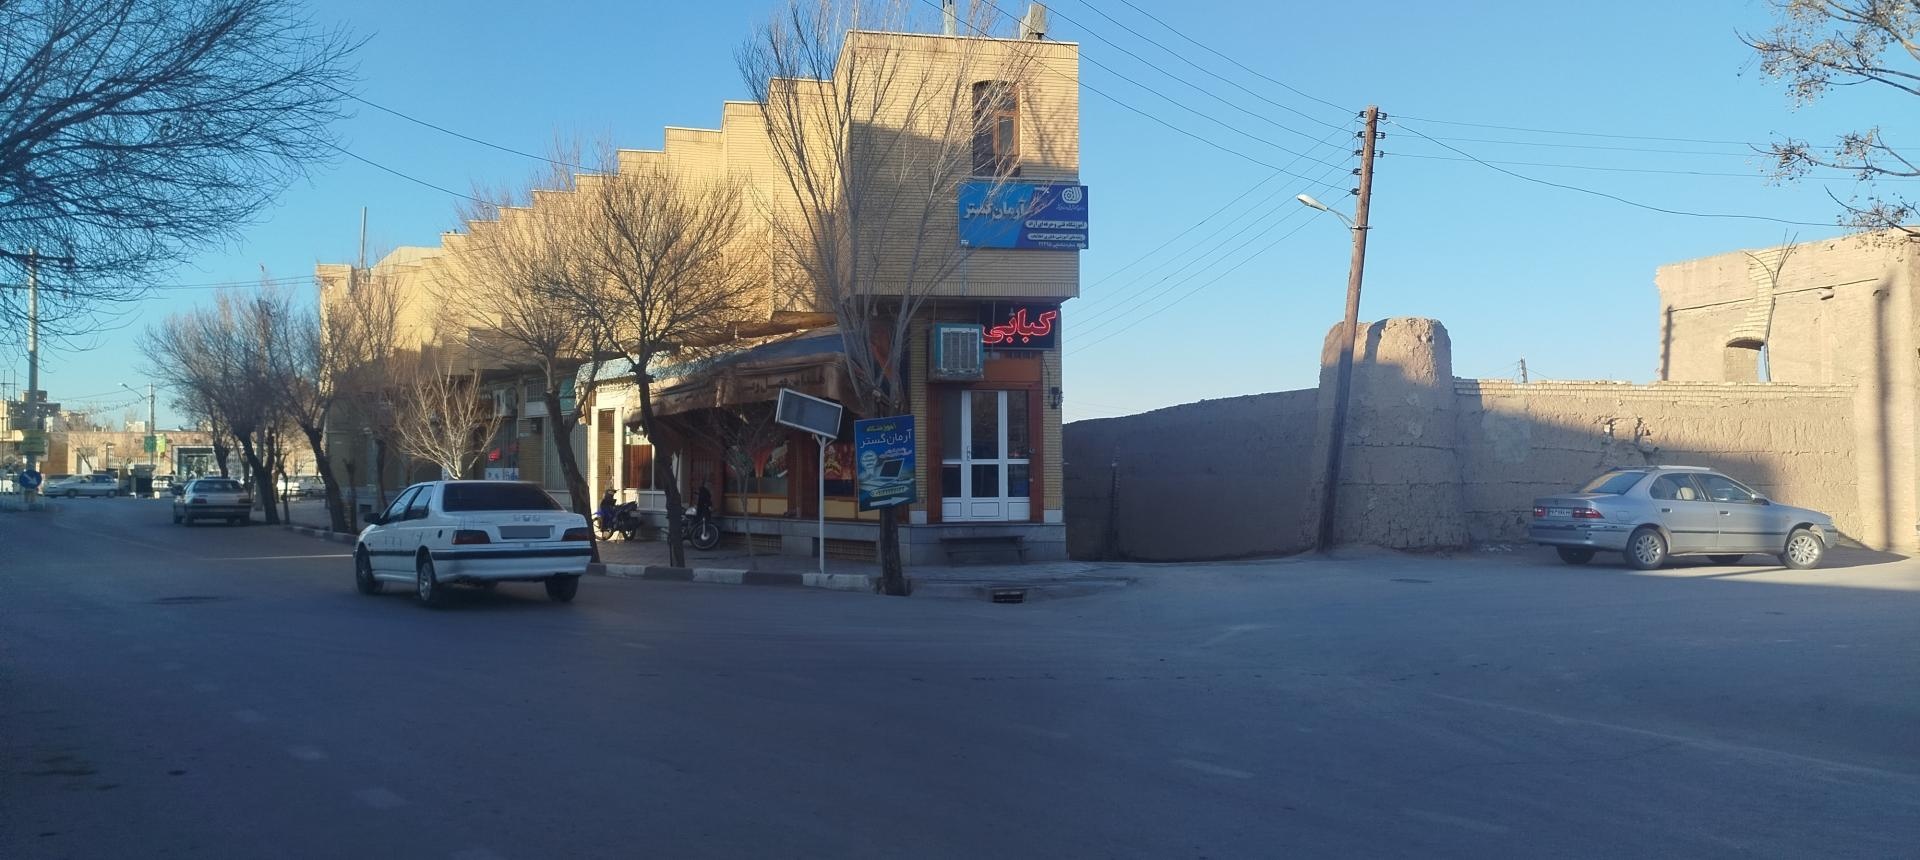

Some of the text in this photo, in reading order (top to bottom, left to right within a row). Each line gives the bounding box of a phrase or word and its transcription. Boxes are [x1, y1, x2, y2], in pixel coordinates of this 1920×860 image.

[964, 199, 1027, 220] آرمان گستر
[982, 308, 1057, 344] کبابی
[860, 428, 913, 449] آرمان گستر
